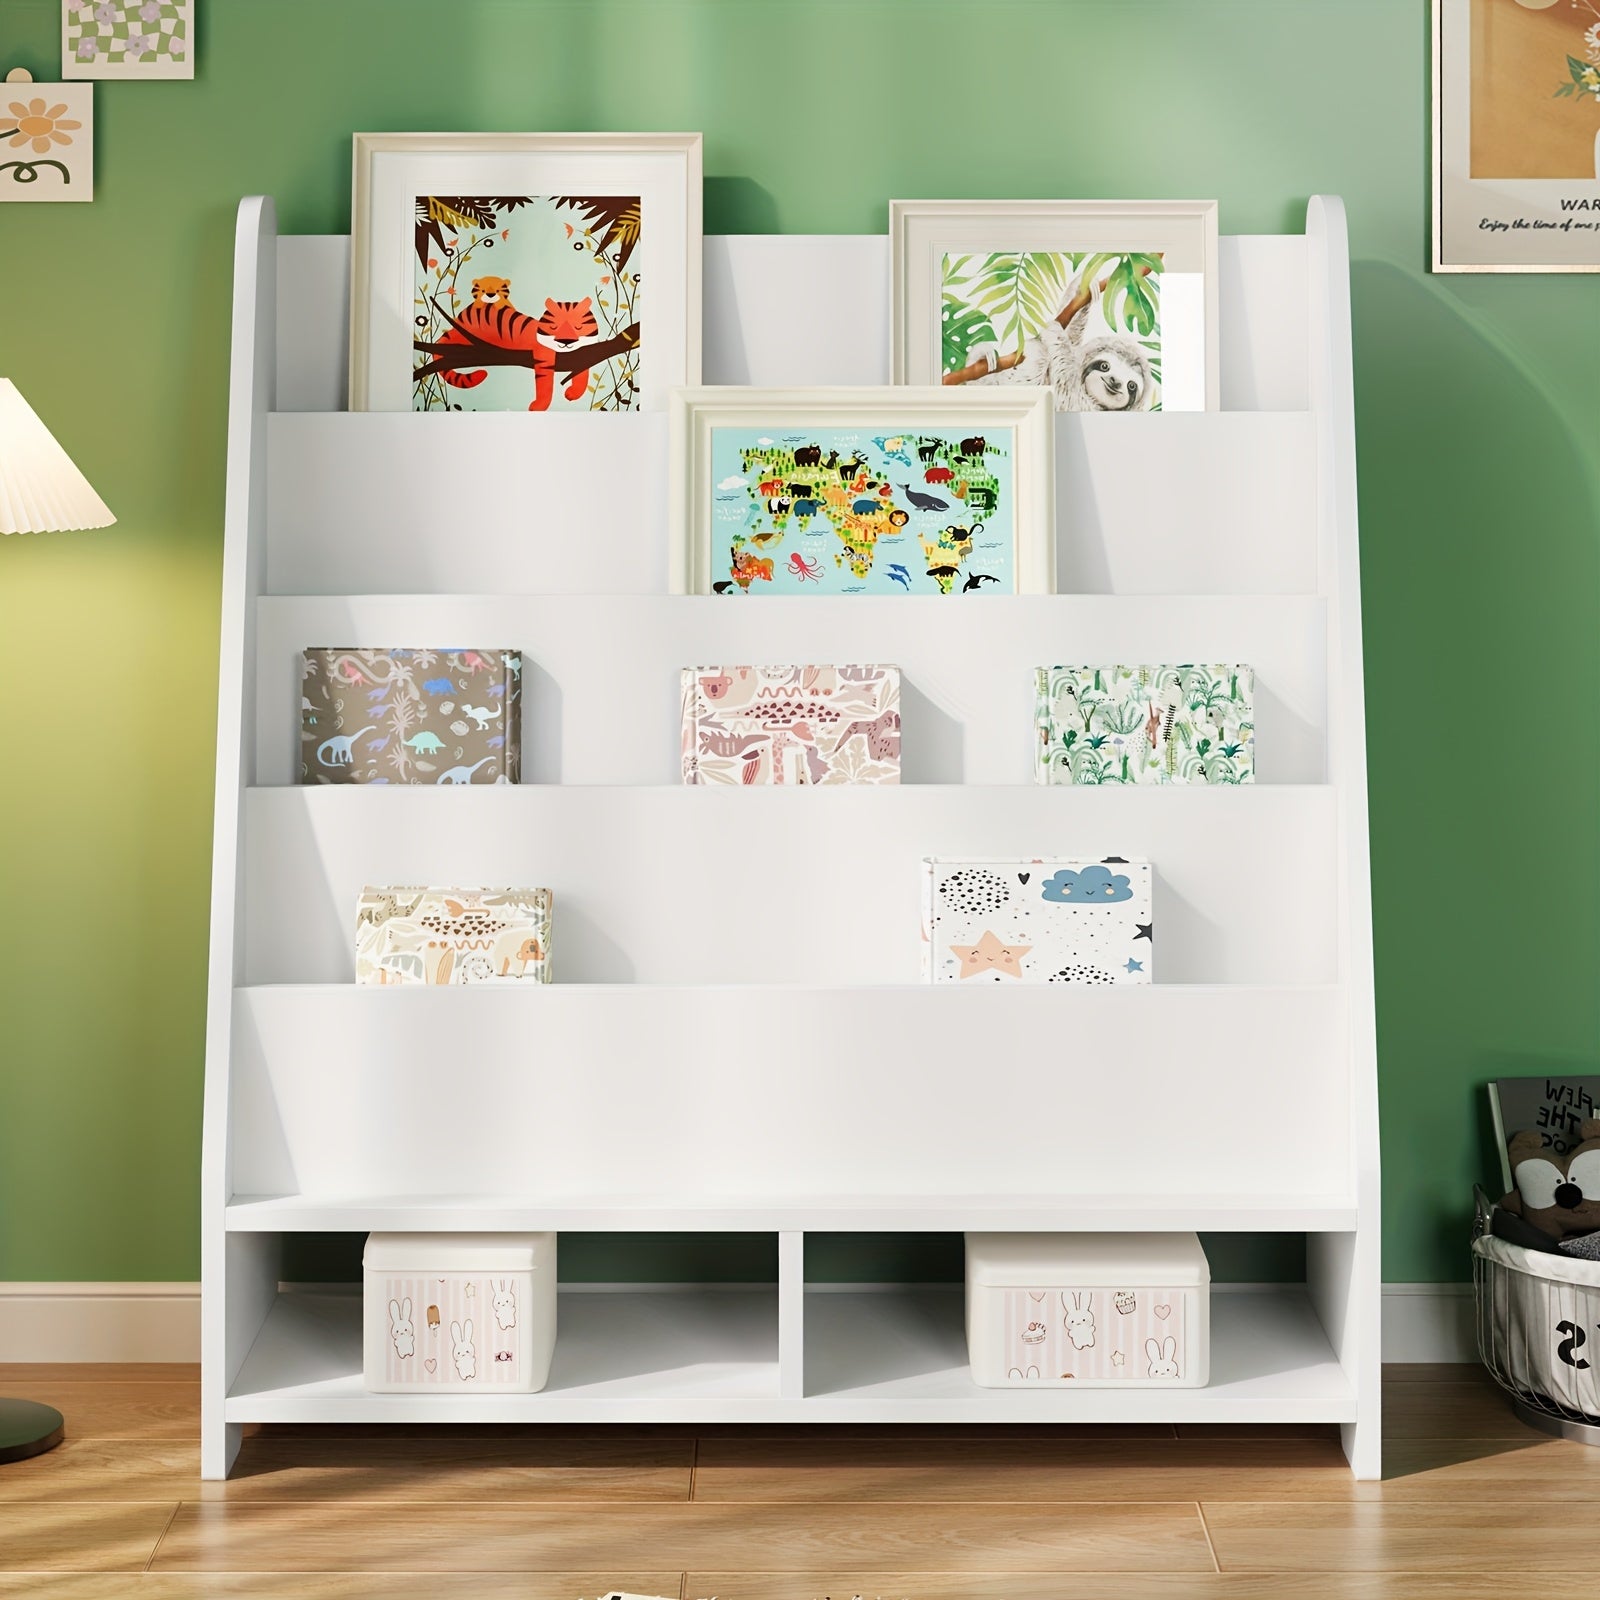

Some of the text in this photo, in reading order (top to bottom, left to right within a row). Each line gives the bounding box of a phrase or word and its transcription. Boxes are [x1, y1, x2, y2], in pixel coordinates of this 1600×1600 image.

[1479, 218, 1509, 232] Enjoy
[1512, 218, 1530, 229] the
[1533, 220, 1557, 229] time
[1560, 218, 1573, 232] of
